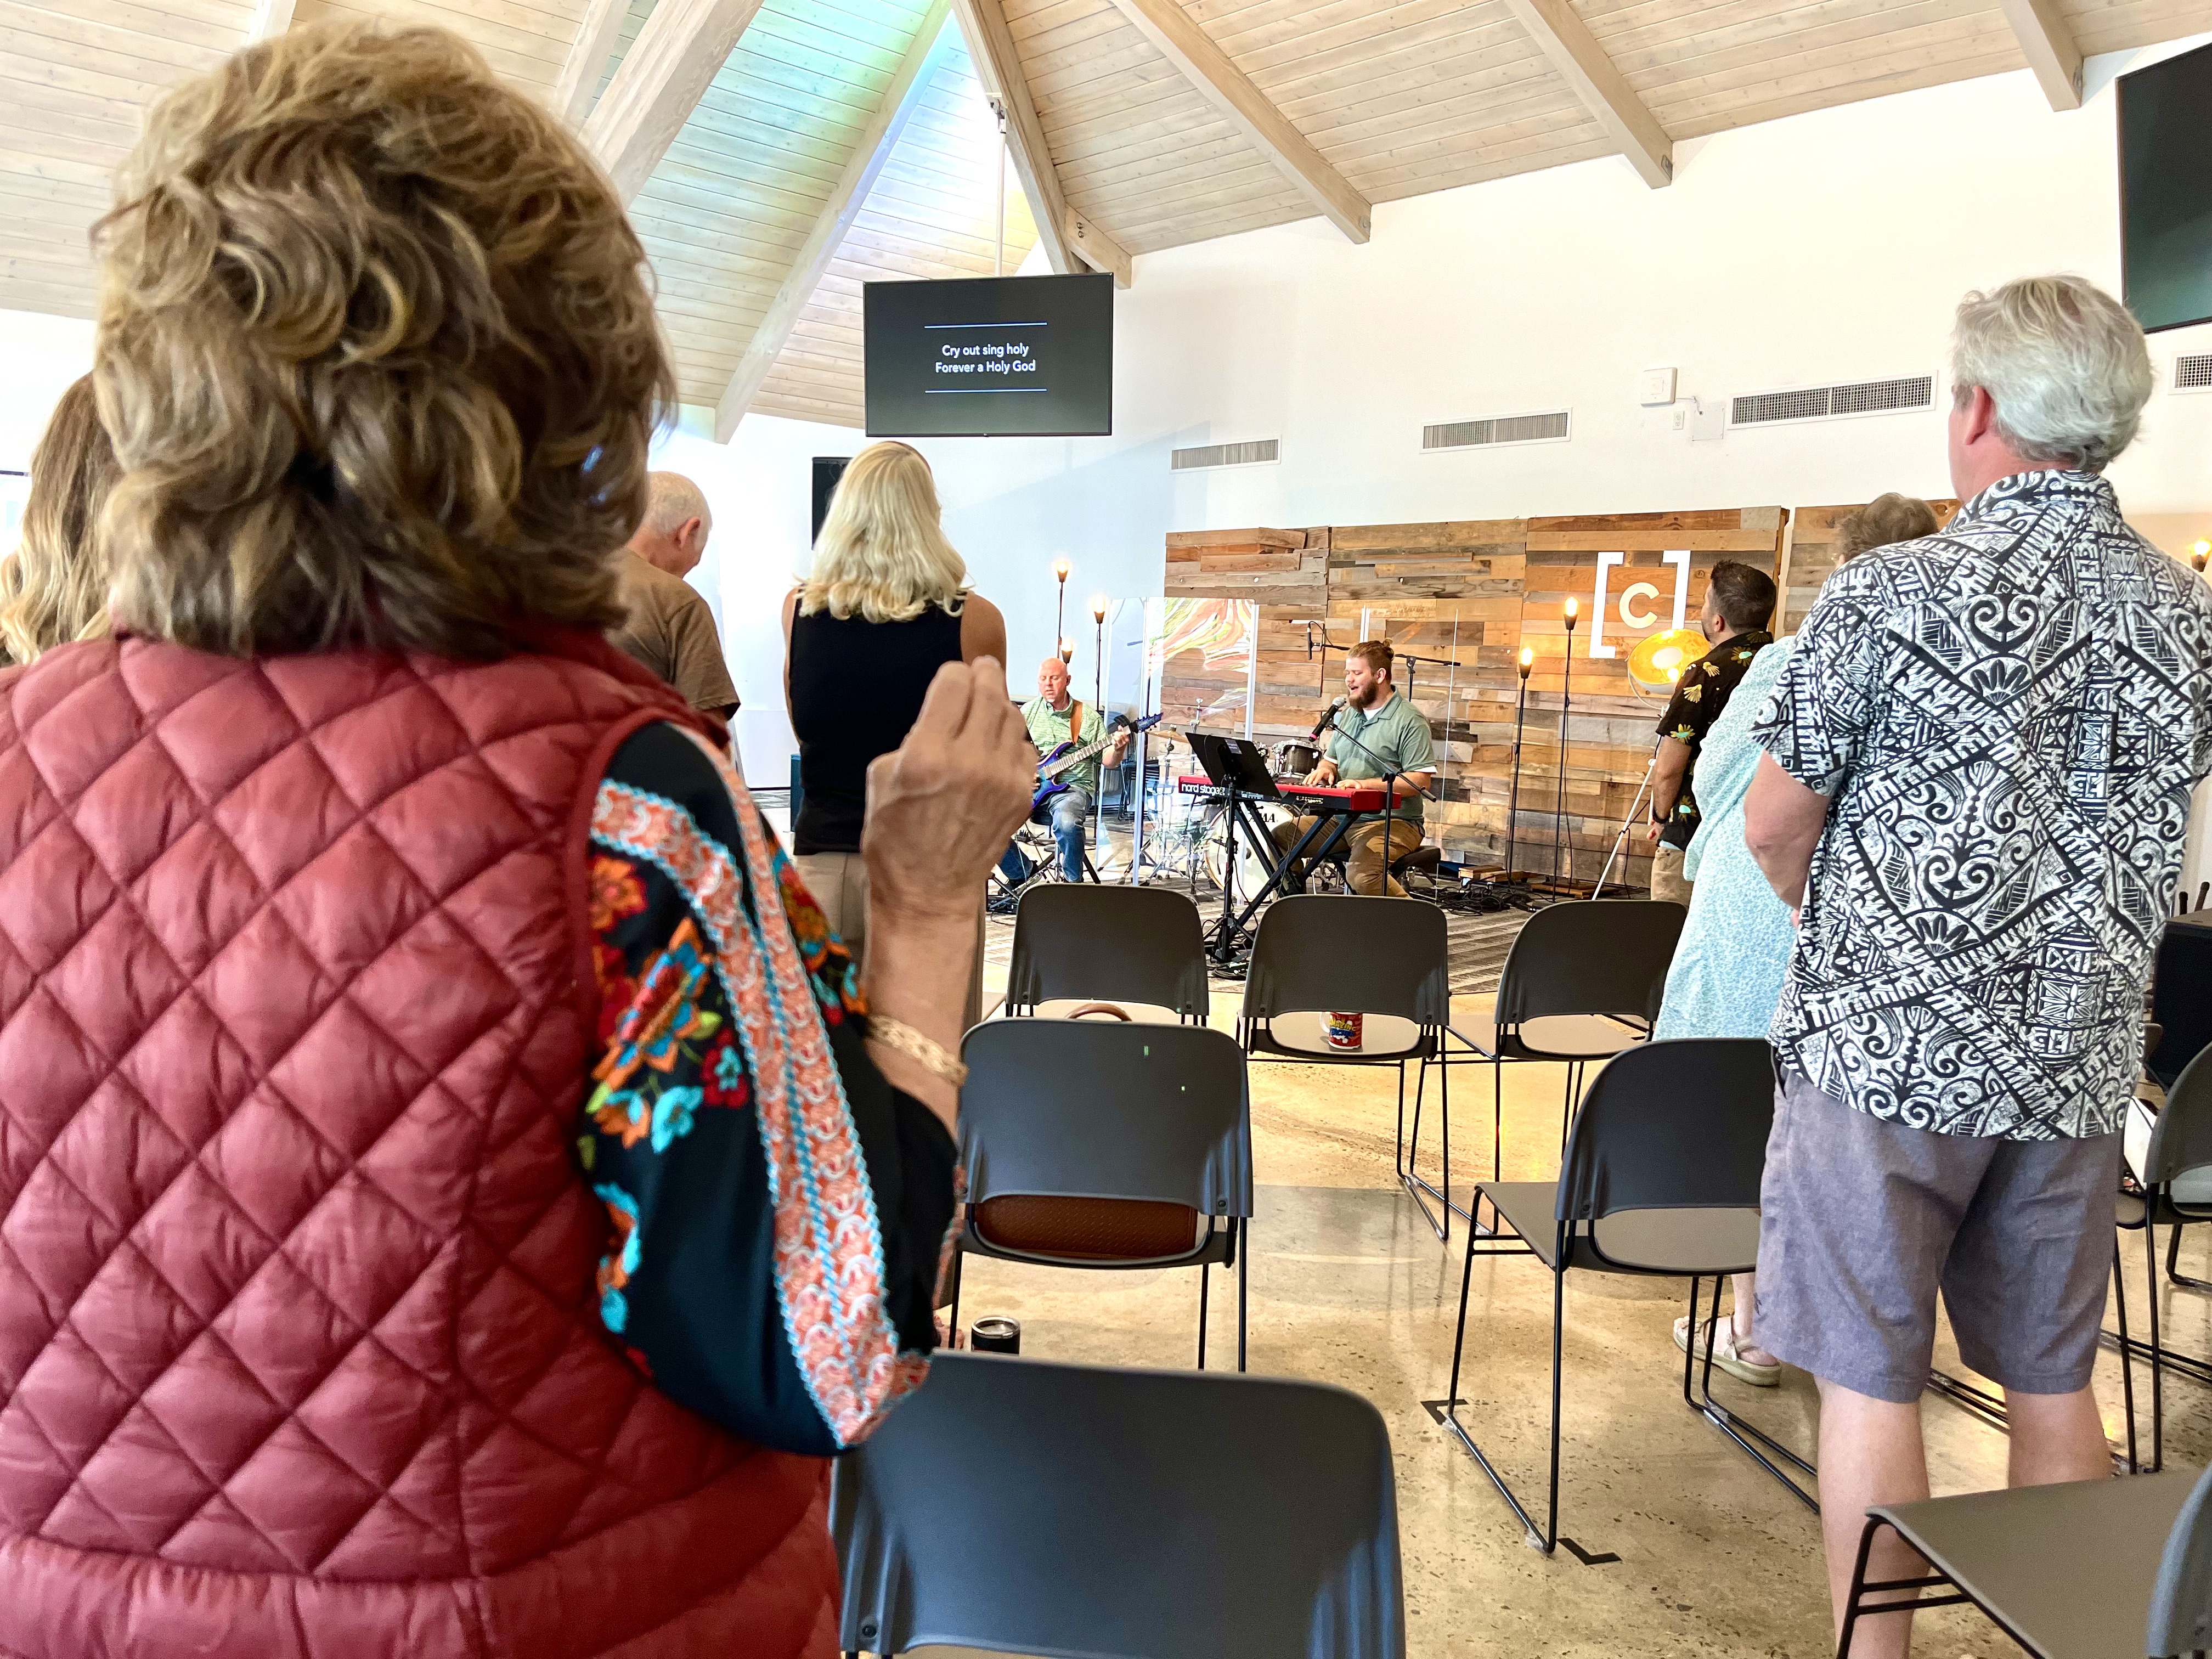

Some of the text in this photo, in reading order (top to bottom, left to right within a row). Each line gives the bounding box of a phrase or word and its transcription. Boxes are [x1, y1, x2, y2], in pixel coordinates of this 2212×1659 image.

[942, 342, 1029, 358] Cry out sing holy
[935, 359, 1036, 375] Forever a Holy God
[1181, 783, 1199, 793] nord
